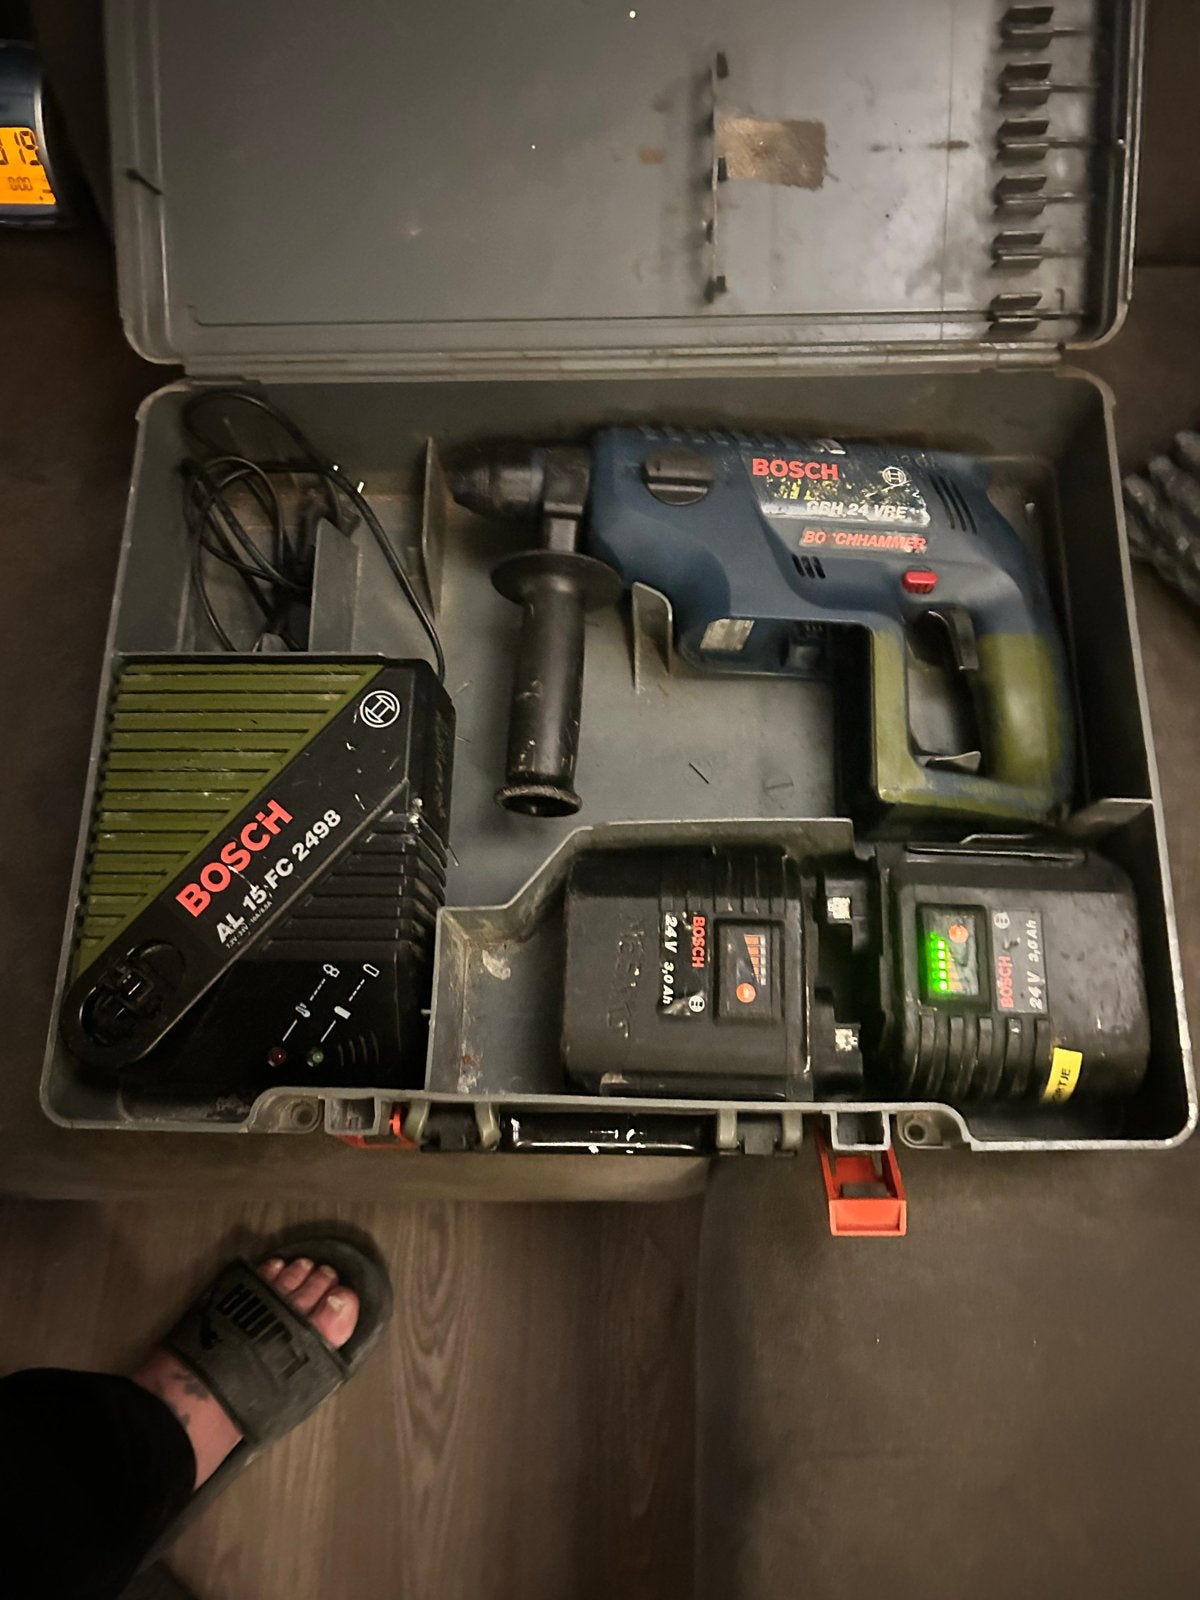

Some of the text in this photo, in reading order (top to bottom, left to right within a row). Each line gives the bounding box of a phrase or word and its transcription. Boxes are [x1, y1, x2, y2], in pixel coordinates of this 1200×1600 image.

[752, 458, 840, 481] BOSCH
[848, 502, 870, 517] 24
[803, 530, 928, 553] BOCHHAMMER
[175, 799, 293, 918] BOSCH
[216, 809, 341, 943] AL 15 FC 2498
[692, 916, 706, 968] BOSCH
[998, 955, 1014, 1008] BOSCH
